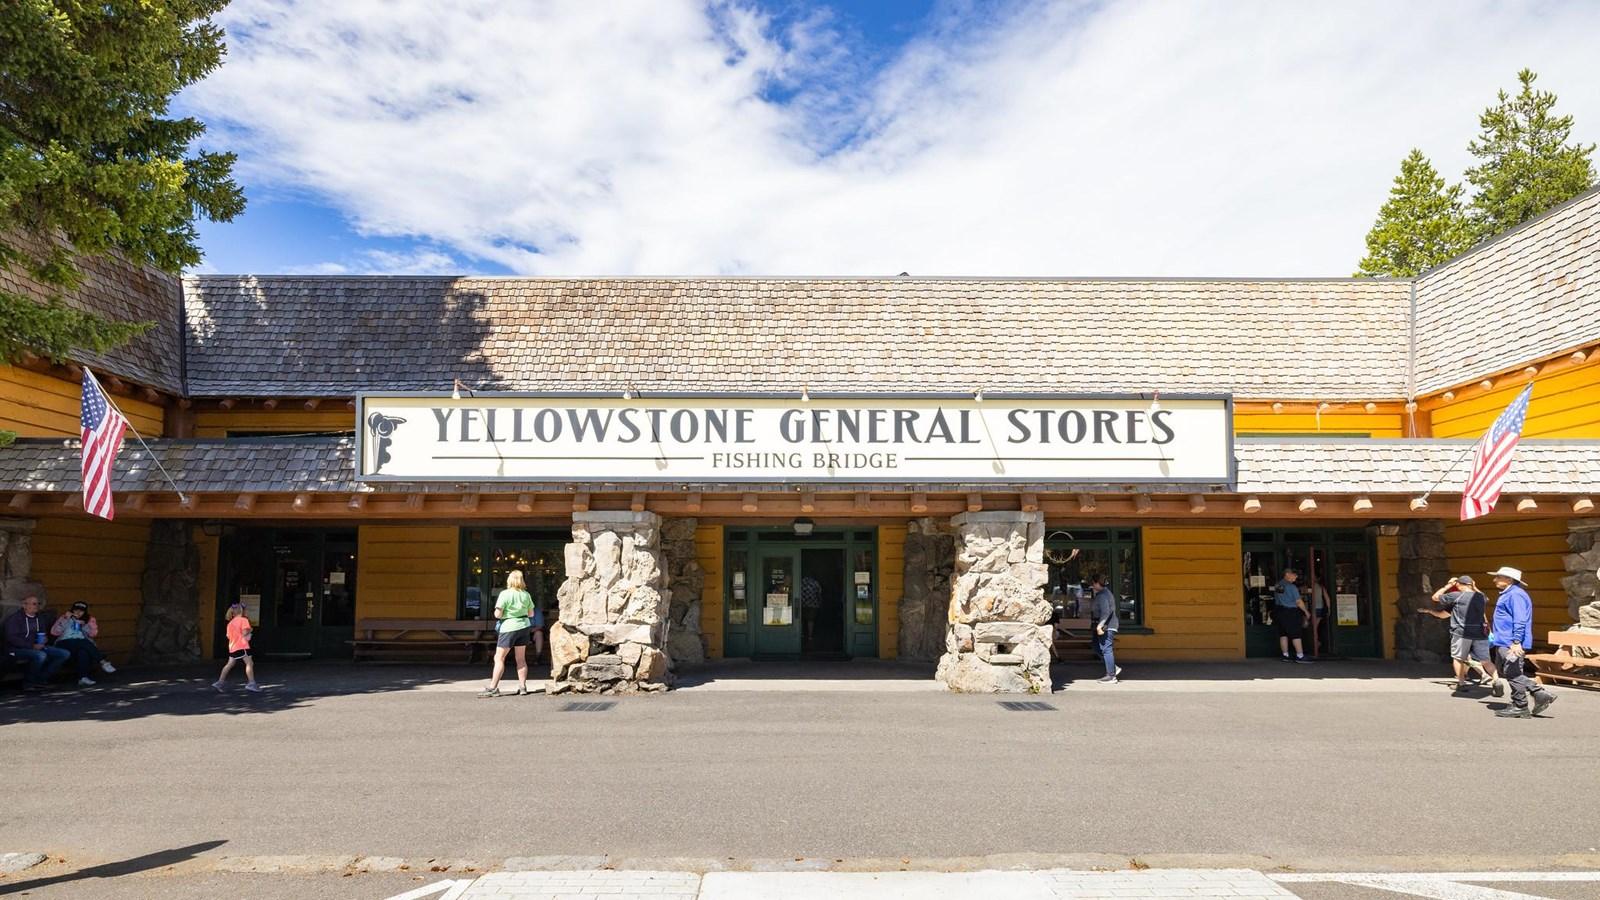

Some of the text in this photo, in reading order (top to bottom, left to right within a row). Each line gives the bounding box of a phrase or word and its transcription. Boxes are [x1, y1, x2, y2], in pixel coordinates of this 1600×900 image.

[432, 406, 1175, 445] YELLOWSTONE GENERAL STORES
[713, 453, 897, 469] FISHING BRIDGE
